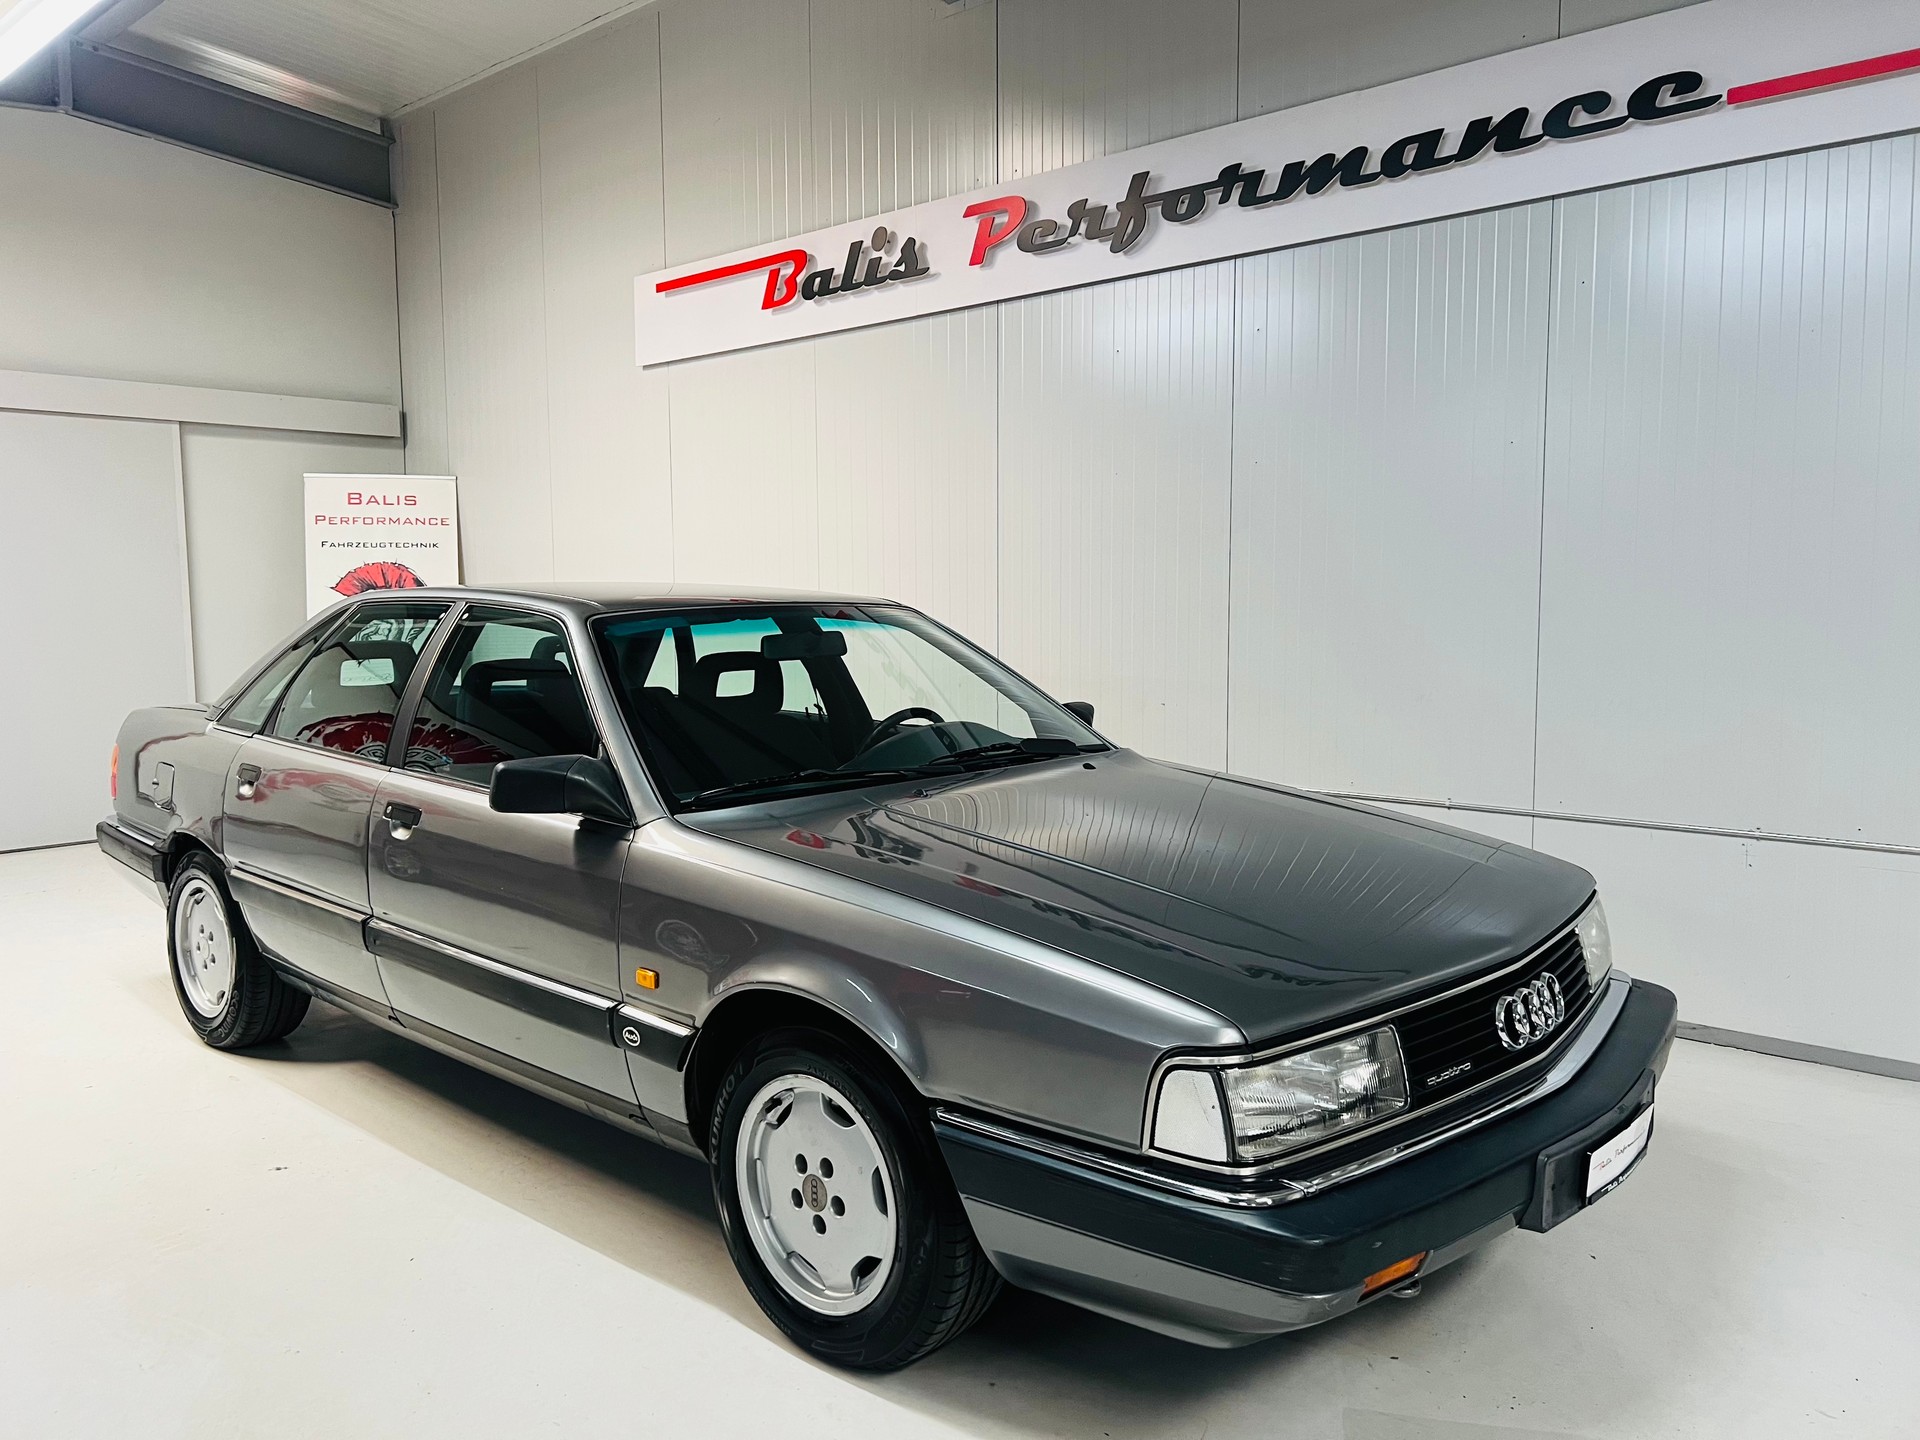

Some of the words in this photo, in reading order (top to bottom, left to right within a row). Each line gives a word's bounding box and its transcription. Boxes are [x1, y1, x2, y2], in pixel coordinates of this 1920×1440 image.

[752, 226, 930, 310] Balis
[963, 70, 1723, 267] Performance
[347, 492, 417, 506] BALIS
[314, 515, 450, 526] PERFORMANCE
[321, 541, 439, 549] FAHRZEUGTECHNIK
[1427, 1061, 1471, 1086] quattro
[711, 1074, 736, 1166] KUMHO
